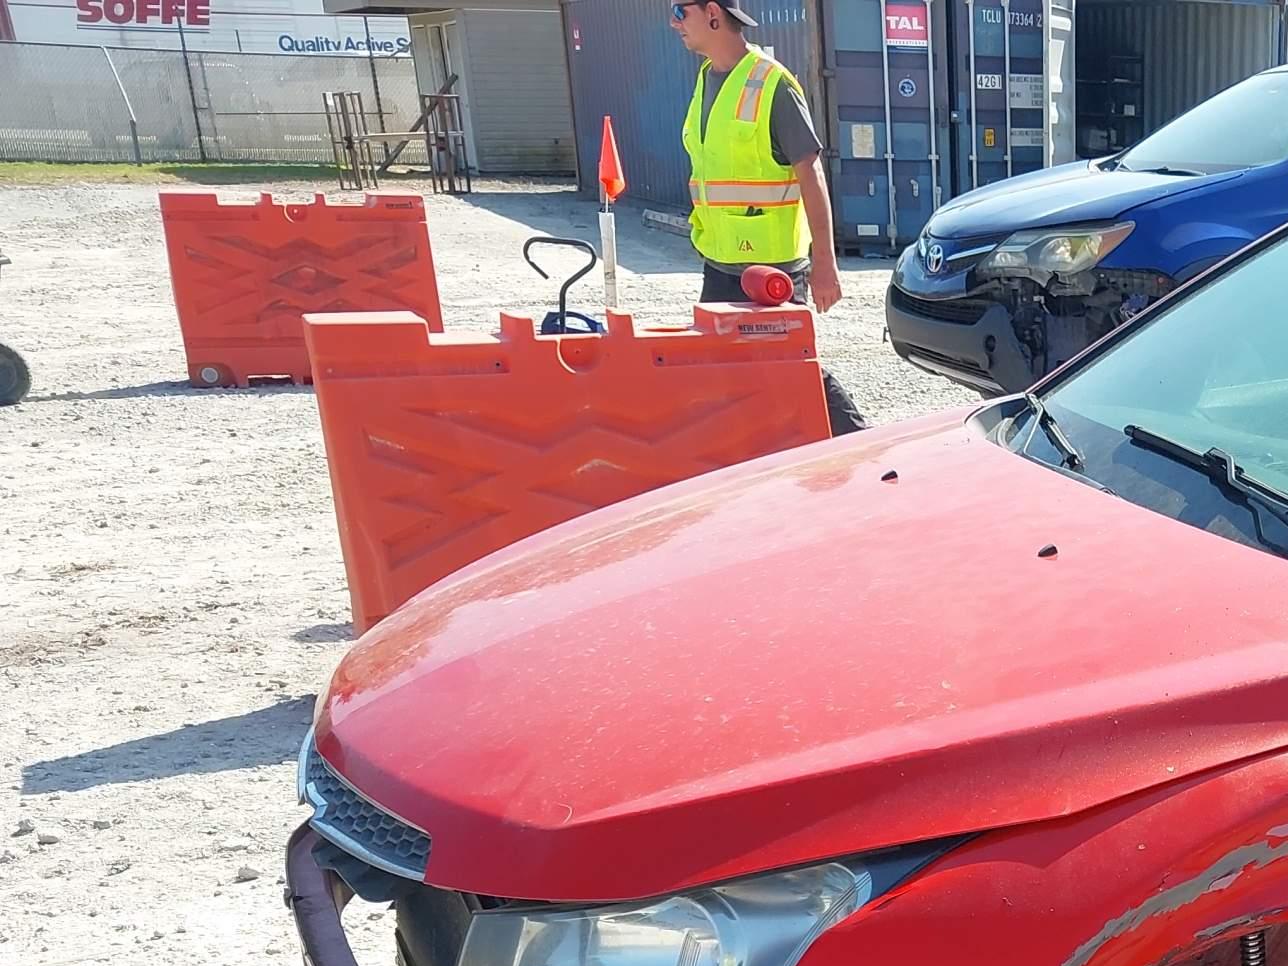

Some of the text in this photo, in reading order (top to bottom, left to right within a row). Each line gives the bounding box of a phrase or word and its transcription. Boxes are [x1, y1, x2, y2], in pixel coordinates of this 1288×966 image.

[76, 0, 210, 25] SOFFE
[982, 9, 1002, 23] TCLU
[886, 16, 924, 30] TAL
[278, 34, 341, 53] Quality
[344, 36, 394, 53] Active
[978, 76, 1001, 88] 42G1
